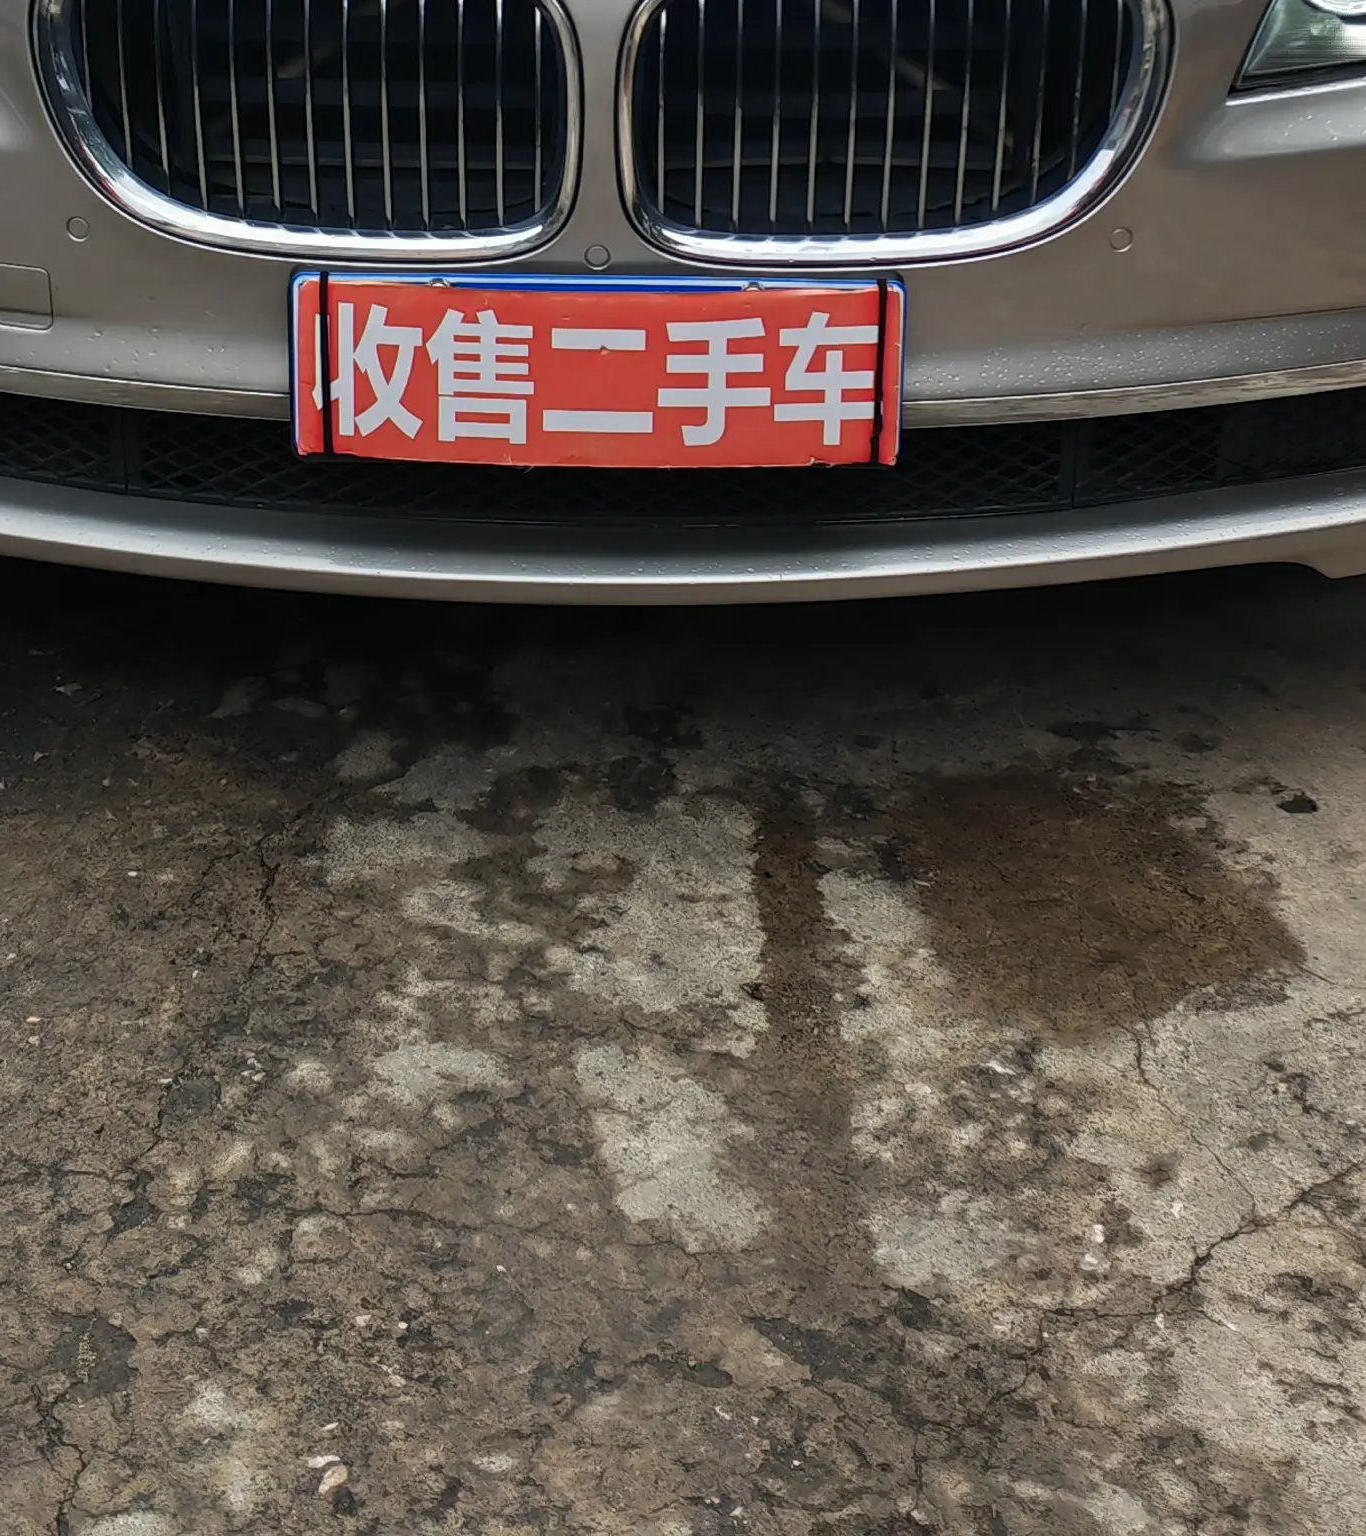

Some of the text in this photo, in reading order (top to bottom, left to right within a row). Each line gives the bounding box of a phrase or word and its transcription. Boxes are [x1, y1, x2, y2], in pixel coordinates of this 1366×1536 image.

[312, 301, 880, 446] 收售二手车
